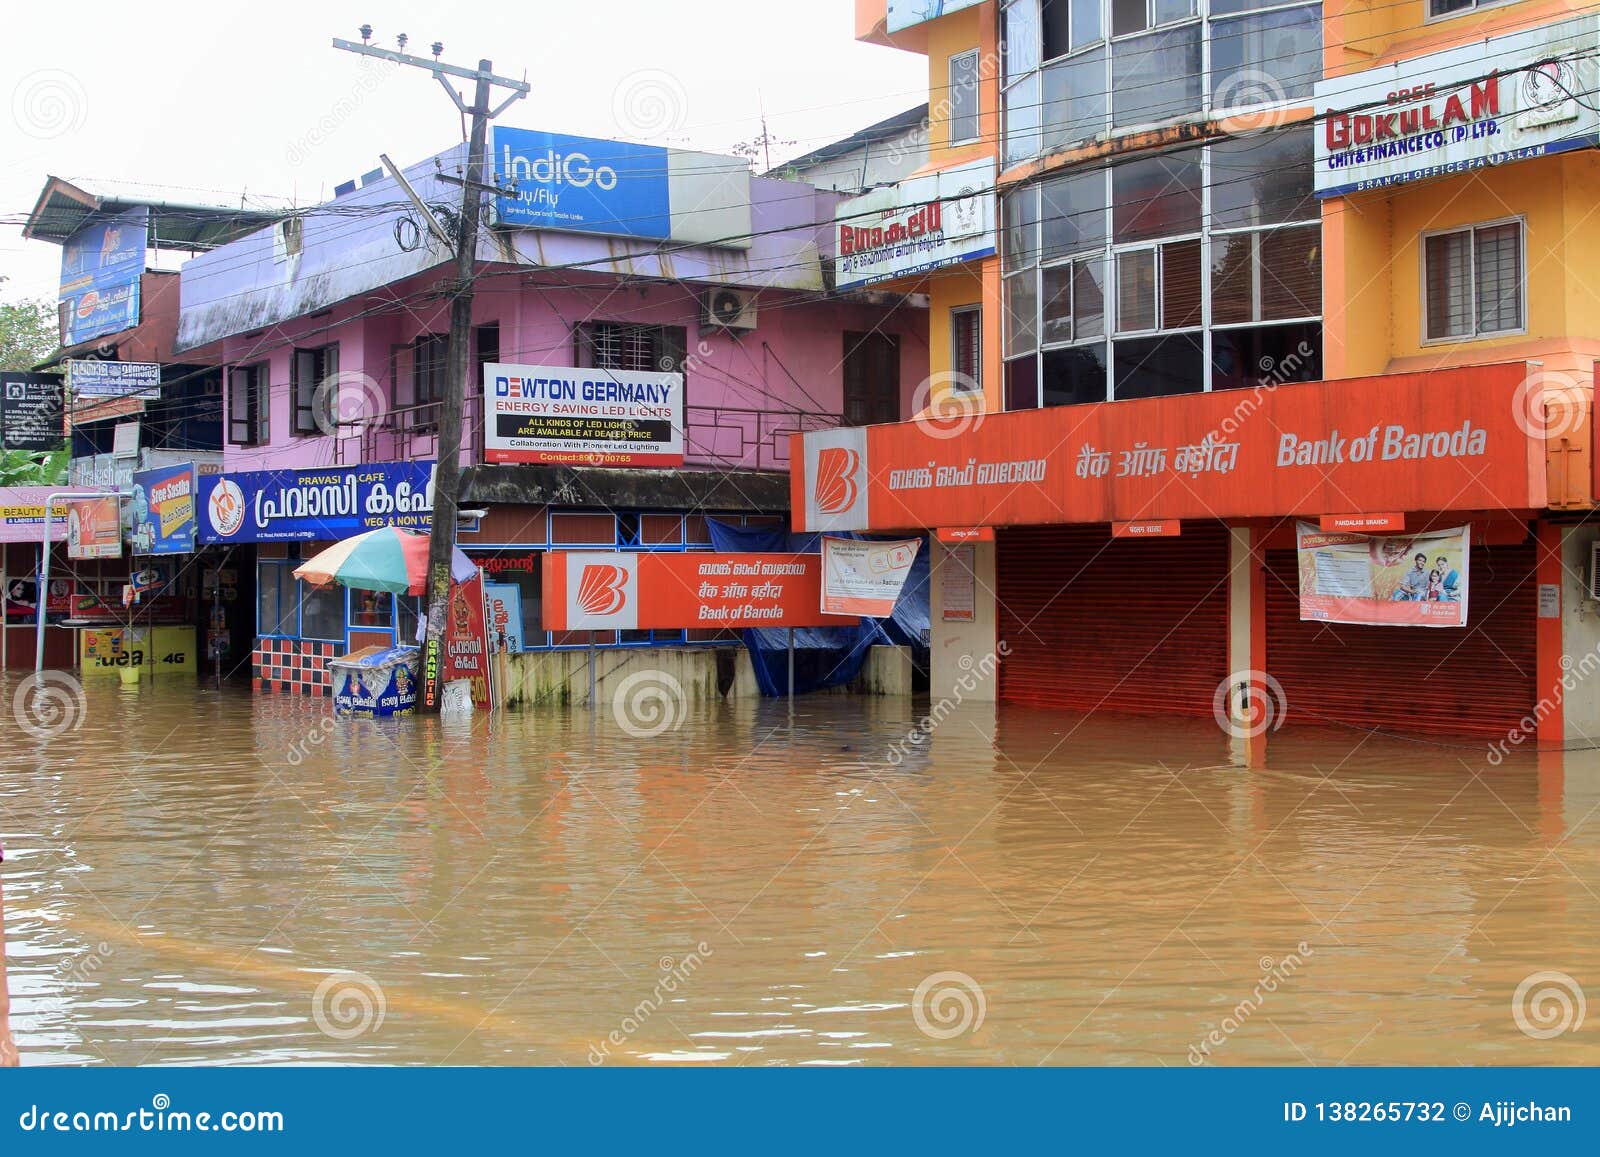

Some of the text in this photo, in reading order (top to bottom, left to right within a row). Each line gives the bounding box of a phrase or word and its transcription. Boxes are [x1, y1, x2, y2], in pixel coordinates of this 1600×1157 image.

[1325, 69, 1499, 151] GOKULAM
[1472, 120, 1501, 139] LTD.
[504, 144, 617, 190] IndiGo
[1357, 146, 1545, 191] BRANCH OFFICE PANDALAM
[496, 376, 671, 404] DEWTON GERMANY
[496, 401, 672, 418] ENERGY SAVING LED LIGHTS
[529, 418, 633, 430] ALL KINDS OF LED LIGHTS
[517, 427, 652, 440] ARE AVAILABLE AT DEALER PRICE
[510, 439, 562, 449] Collaboration
[564, 441, 581, 449] With
[614, 442, 627, 450] Led
[629, 442, 660, 452] Lighting
[1277, 419, 1487, 467] Bank of Baroda
[1076, 433, 1240, 479] बैंक ऑफ़ बड़ौदा
[298, 473, 385, 485] PRAVASI CAFE
[889, 458, 1046, 490] ബാങ്ക് ഓഫ് ബറോഡ
[151, 479, 190, 505] Sree Sastha
[255, 474, 436, 529] പ്രവാസി കഫേ
[3, 507, 41, 517] BEAUTY
[364, 515, 433, 527] VEG. & NON VE
[1335, 517, 1389, 527] PANDALAM BRANCH
[698, 560, 806, 576] ബാങ്ക് ഓഫ് ബറോഡ
[698, 580, 719, 598] बैंक
[751, 581, 783, 600] बड़ौदा
[698, 604, 784, 619] Bank of Baroda
[448, 636, 482, 658] പ്രവാസി
[163, 652, 185, 664] 4G
[454, 656, 479, 670] കഫേ
